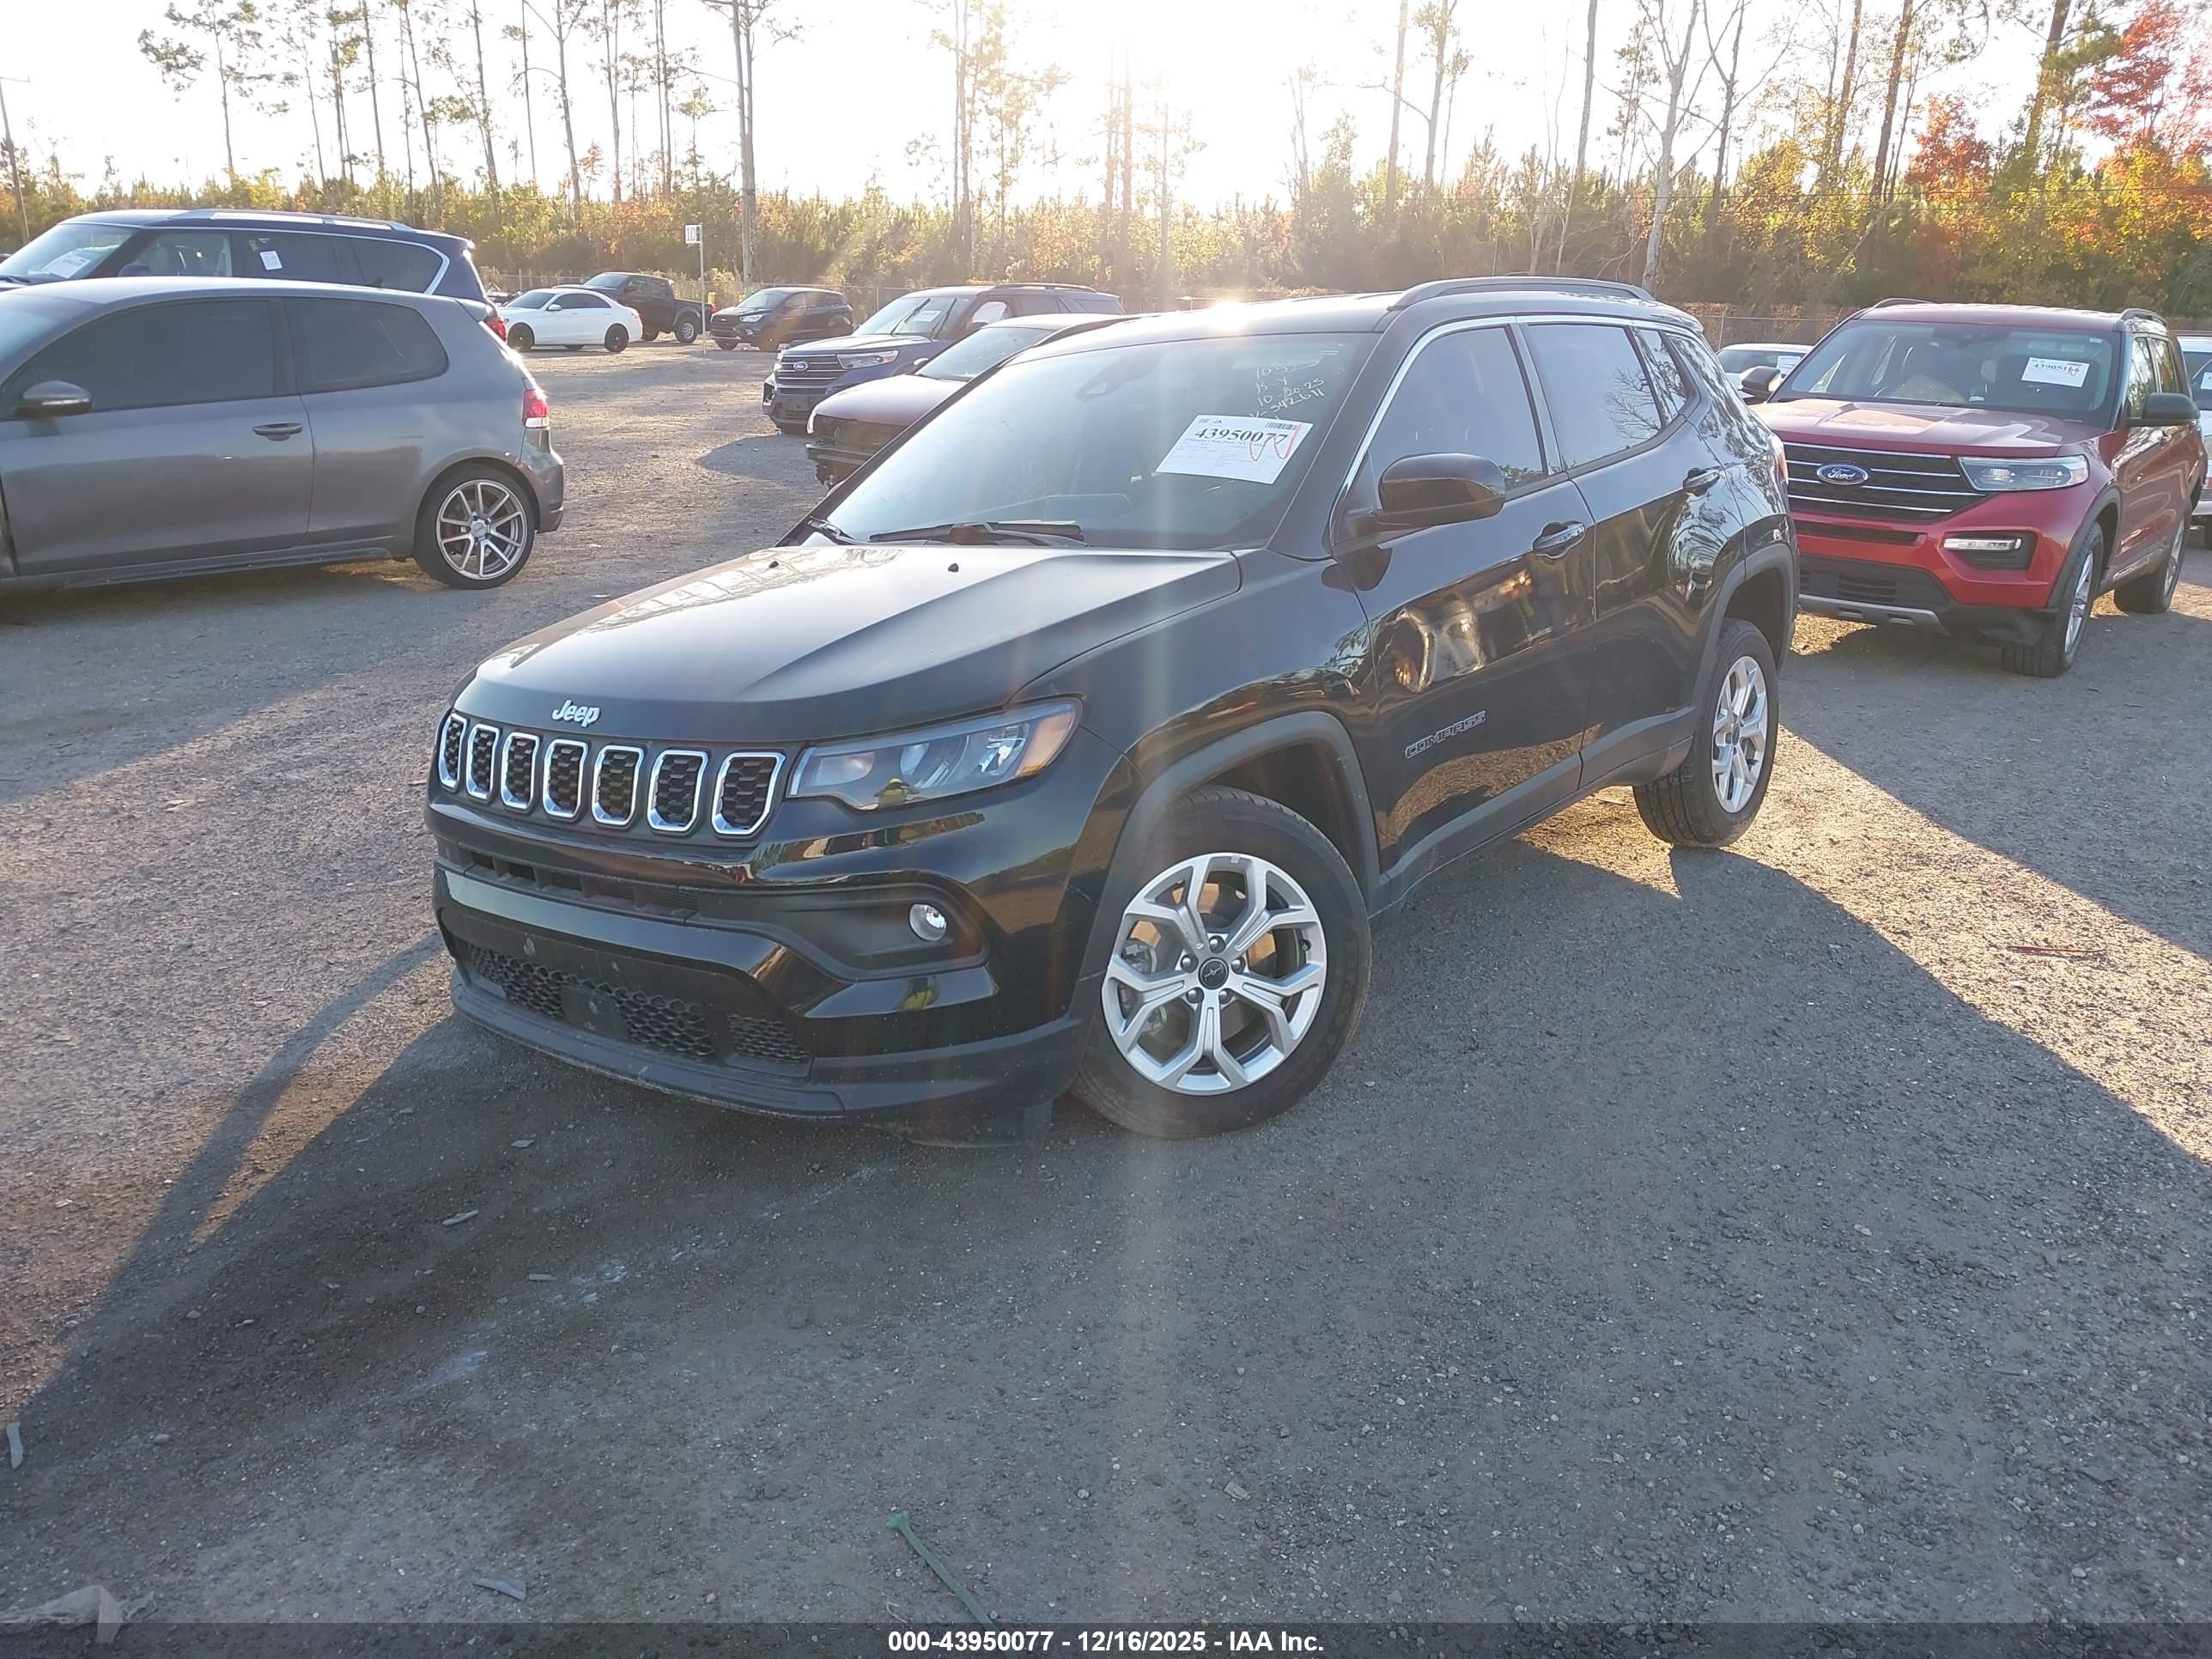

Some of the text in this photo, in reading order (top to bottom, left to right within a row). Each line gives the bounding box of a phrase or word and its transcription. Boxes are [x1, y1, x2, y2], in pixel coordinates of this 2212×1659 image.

[1194, 428, 1289, 445] 43950077
[1827, 467, 1856, 480] Ford
[552, 699, 600, 728] Jeep
[1404, 710, 1486, 759] COMPASS
